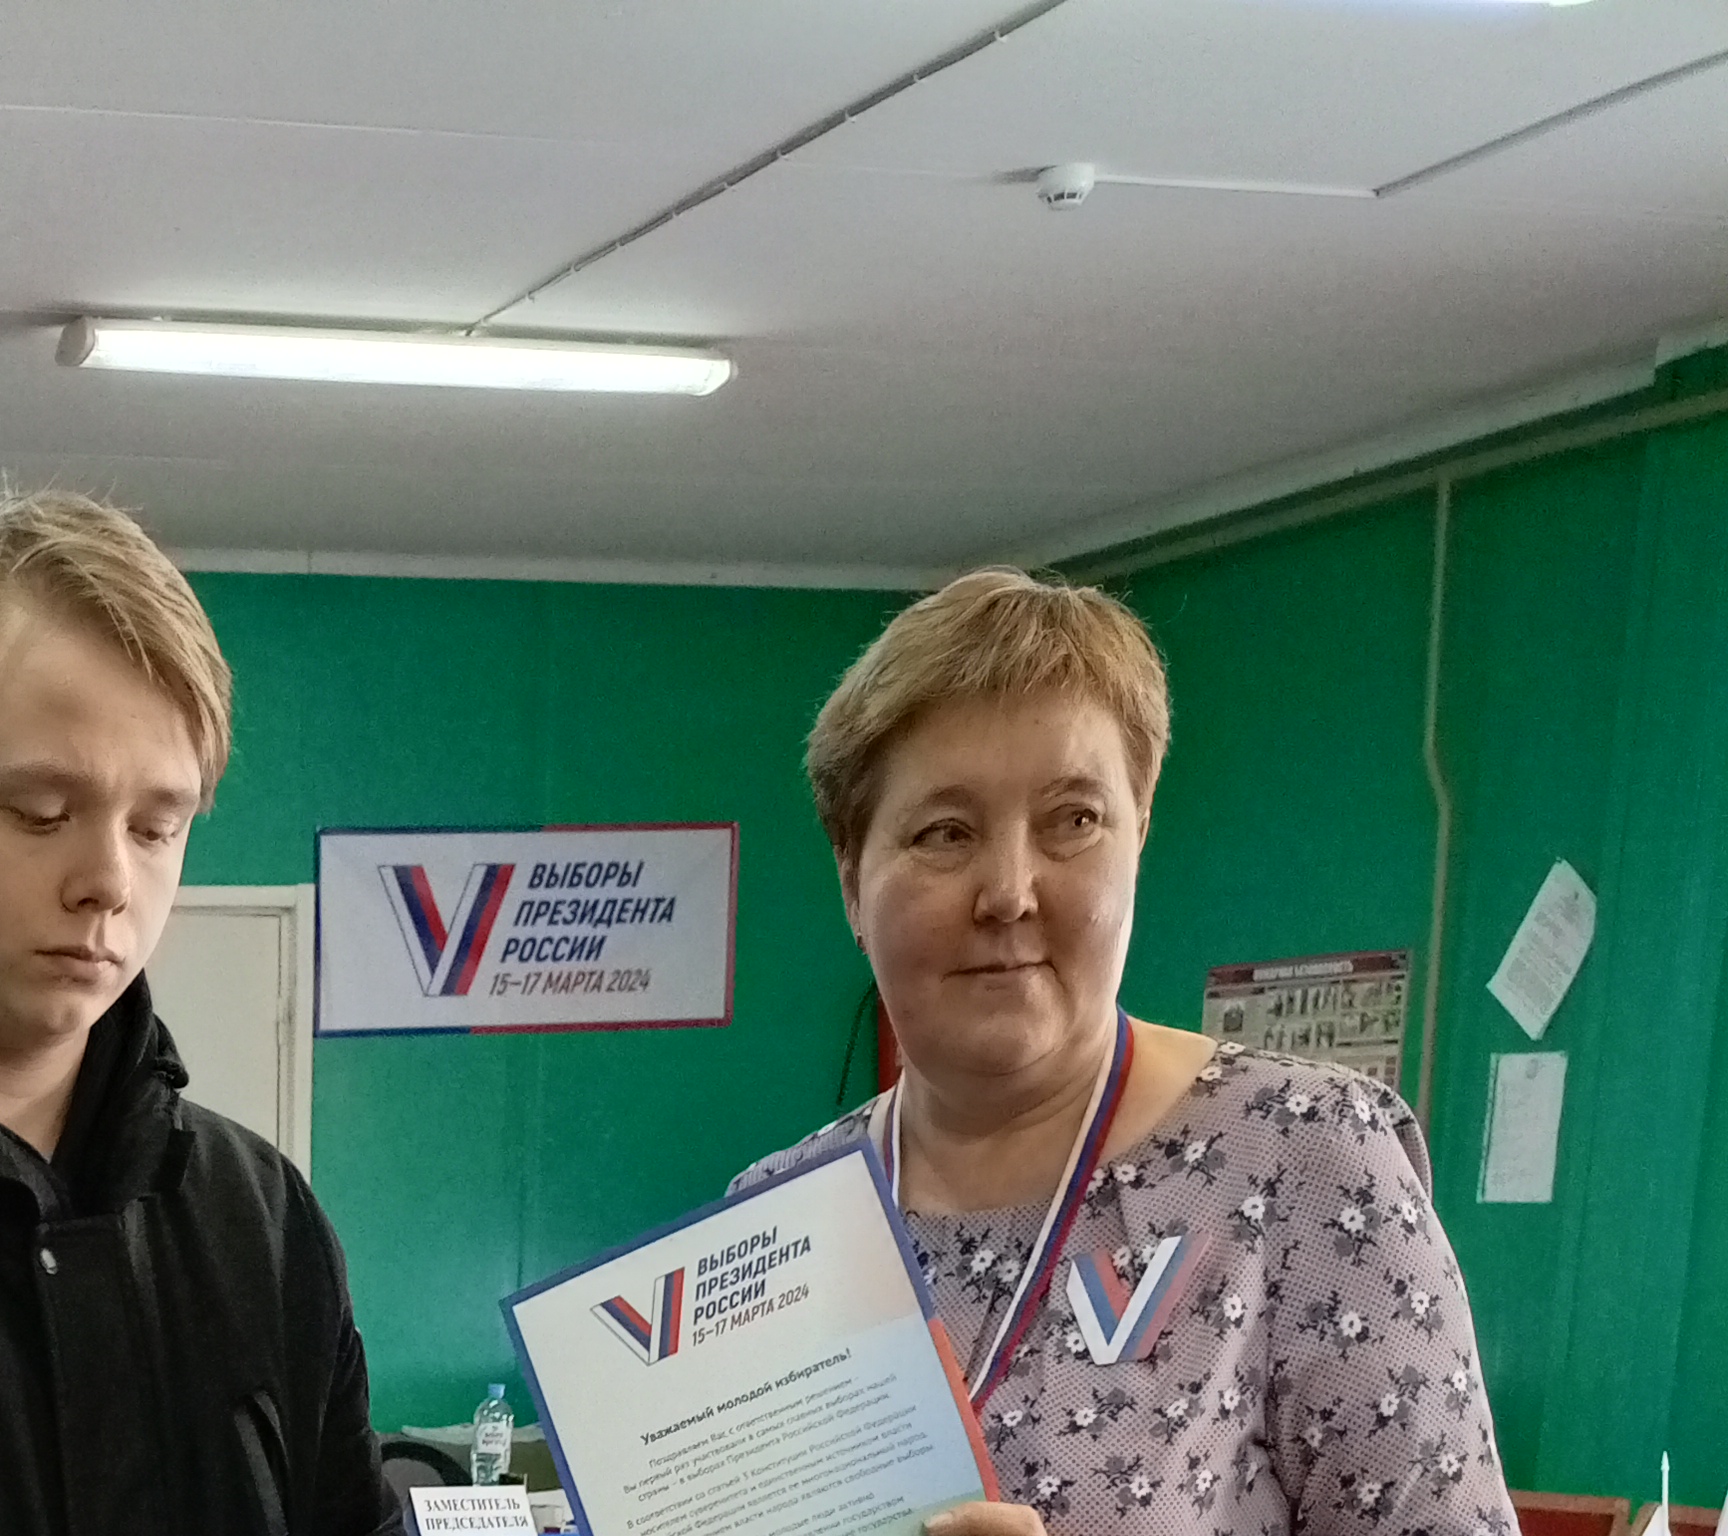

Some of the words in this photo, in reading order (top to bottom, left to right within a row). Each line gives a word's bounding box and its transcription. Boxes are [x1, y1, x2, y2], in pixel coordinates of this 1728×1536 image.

[528, 860, 644, 890] ВЫБОРЫ
[514, 896, 676, 928] ПРЕЗИДЕНТА
[500, 935, 607, 964] РОССИИ
[543, 969, 605, 995] МАРТА
[606, 968, 651, 993] 2024
[695, 1235, 812, 1301] ПРЕЗИДЕНТА
[697, 1226, 778, 1278] ВЫБОРЫ
[693, 1280, 766, 1325] РОССИИ
[729, 1301, 775, 1334] МАРТА
[777, 1284, 810, 1315] 2024
[640, 1405, 714, 1446] Уважаемый
[713, 1380, 773, 1414] молодой
[772, 1346, 853, 1391] избиратель!
[781, 1413, 834, 1441] Российской
[749, 1447, 808, 1478] Конституции
[808, 1424, 862, 1453] Российской
[424, 1498, 521, 1512] ЗАМЕСТИТЕЛЬ
[425, 1515, 529, 1531] ПРЕДСЕДАТЕЛЯ
